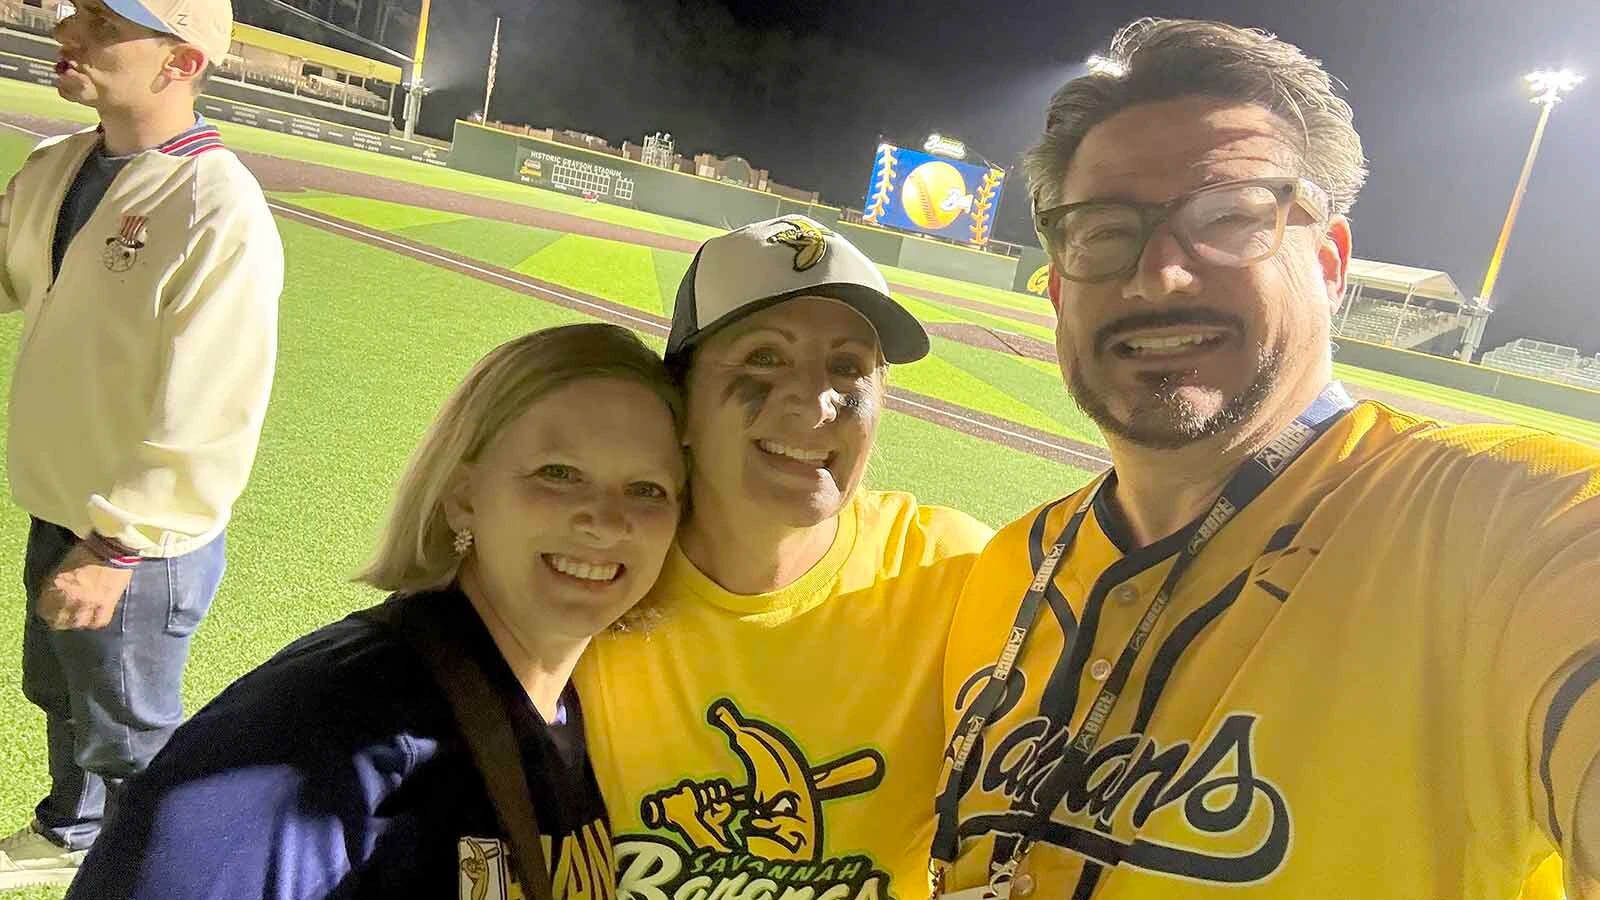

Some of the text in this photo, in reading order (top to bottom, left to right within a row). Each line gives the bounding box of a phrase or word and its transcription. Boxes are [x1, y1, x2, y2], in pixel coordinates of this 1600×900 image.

[530, 151, 561, 165] HISTORIC
[593, 165, 622, 177] STADIUM
[689, 852, 863, 882] SAVANNAH
